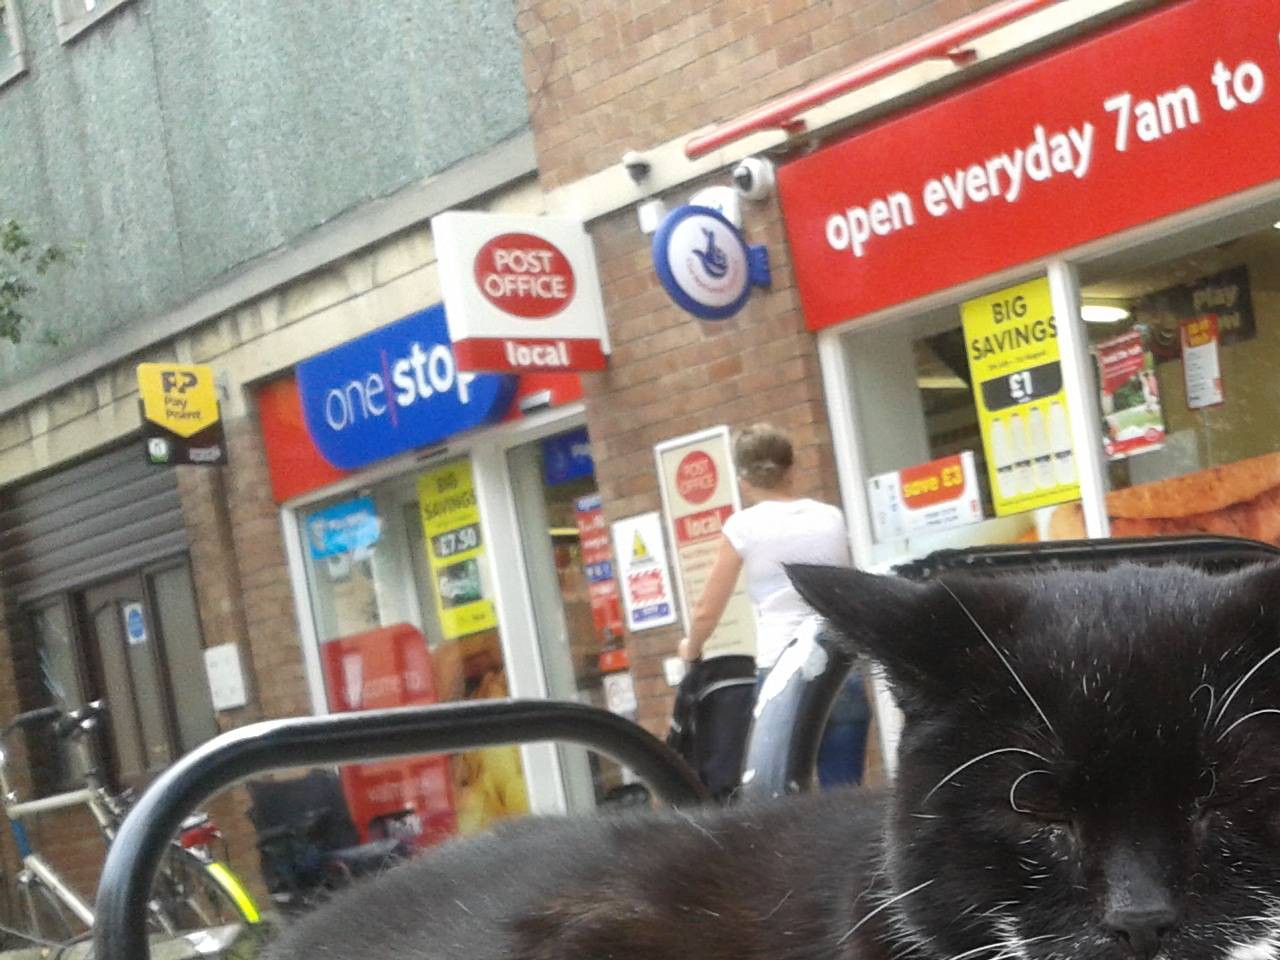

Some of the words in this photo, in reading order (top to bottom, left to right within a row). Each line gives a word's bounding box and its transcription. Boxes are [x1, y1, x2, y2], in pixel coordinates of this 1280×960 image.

[825, 191, 917, 257] open
[923, 122, 1095, 217] everyday
[1103, 84, 1201, 153] 7am
[1210, 60, 1266, 111] to
[493, 249, 554, 274] POST
[484, 274, 567, 299] OFFICE
[992, 295, 1028, 324] BIG
[971, 315, 1058, 360] SAVINGS
[504, 340, 570, 367] local
[1008, 371, 1034, 399] £1
[326, 373, 387, 431] one
